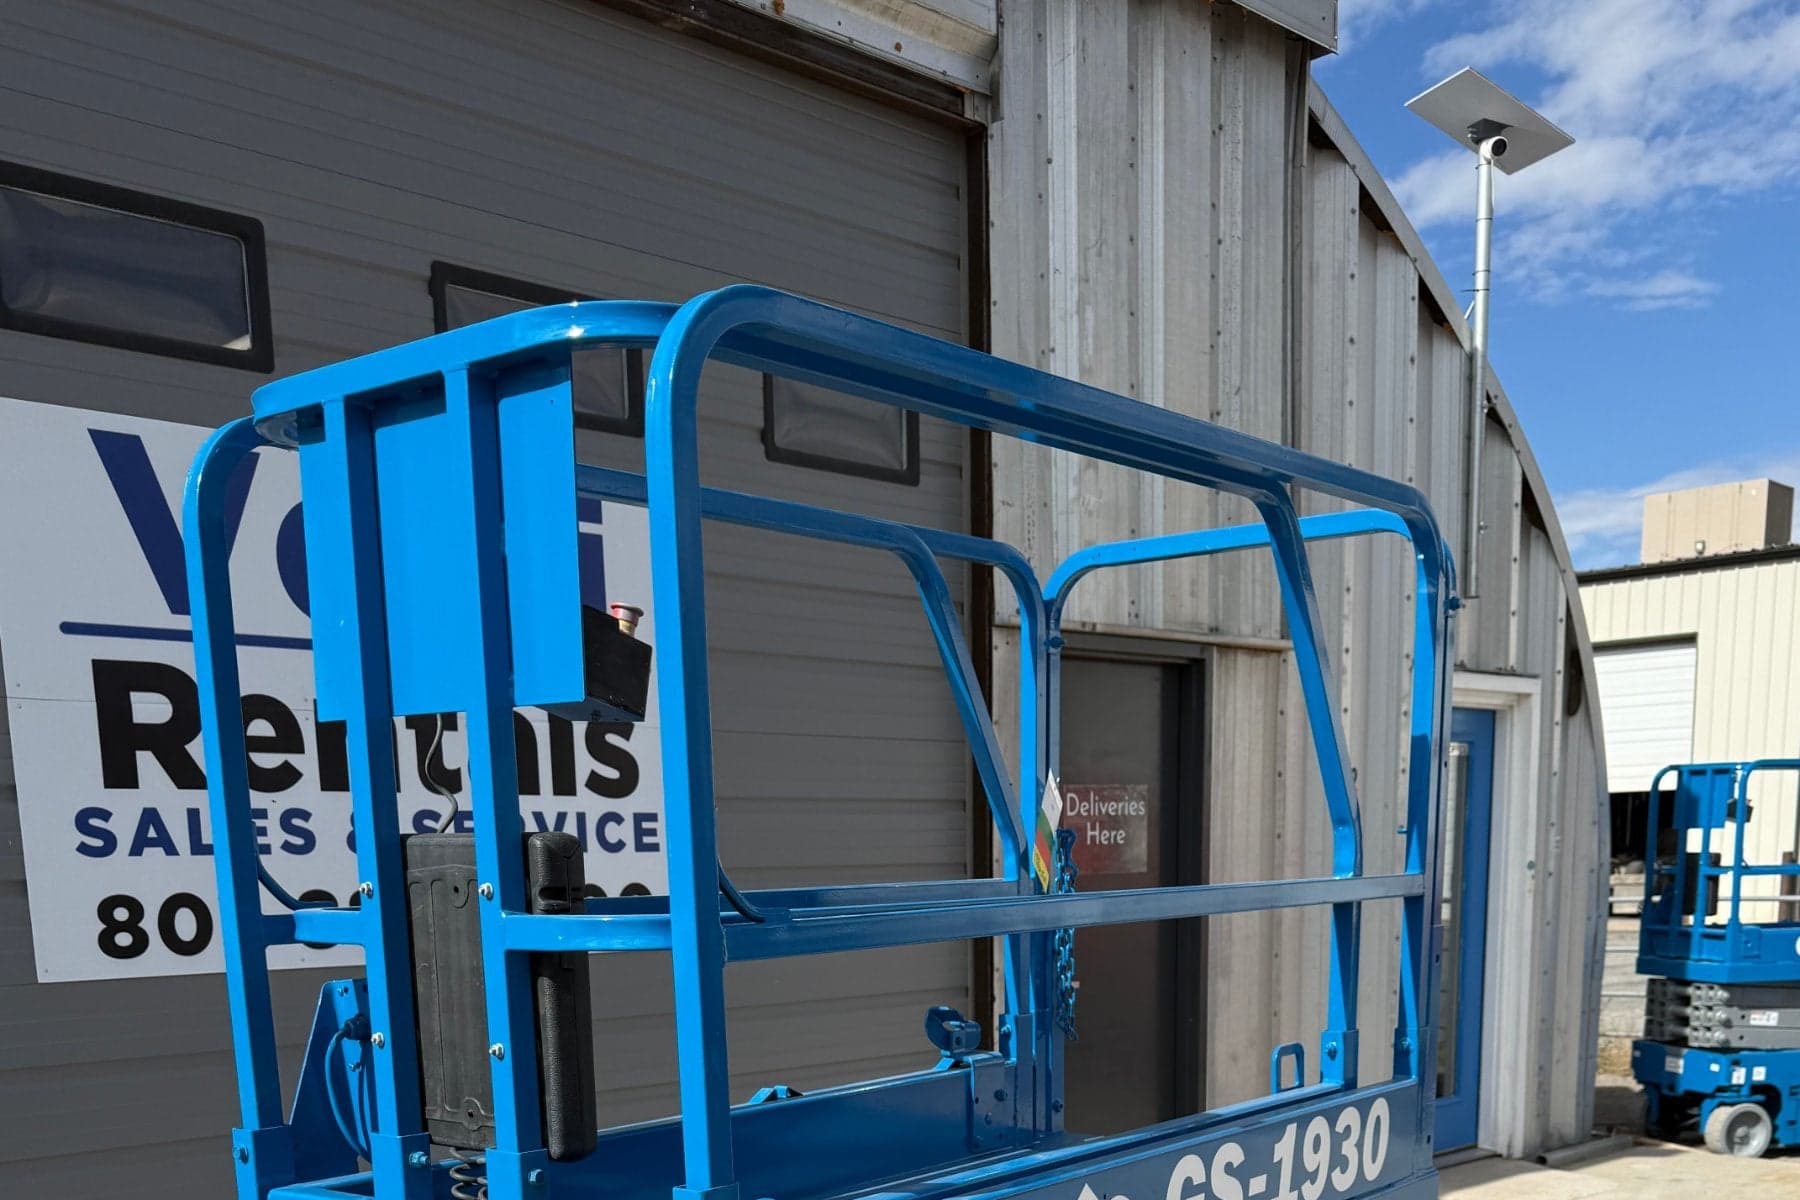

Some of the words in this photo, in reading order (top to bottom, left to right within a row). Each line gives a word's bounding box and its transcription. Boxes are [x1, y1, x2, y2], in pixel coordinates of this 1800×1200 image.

[1066, 791, 1146, 816] Deliveries
[412, 808, 660, 854] SVICE
[1087, 821, 1126, 845] Here
